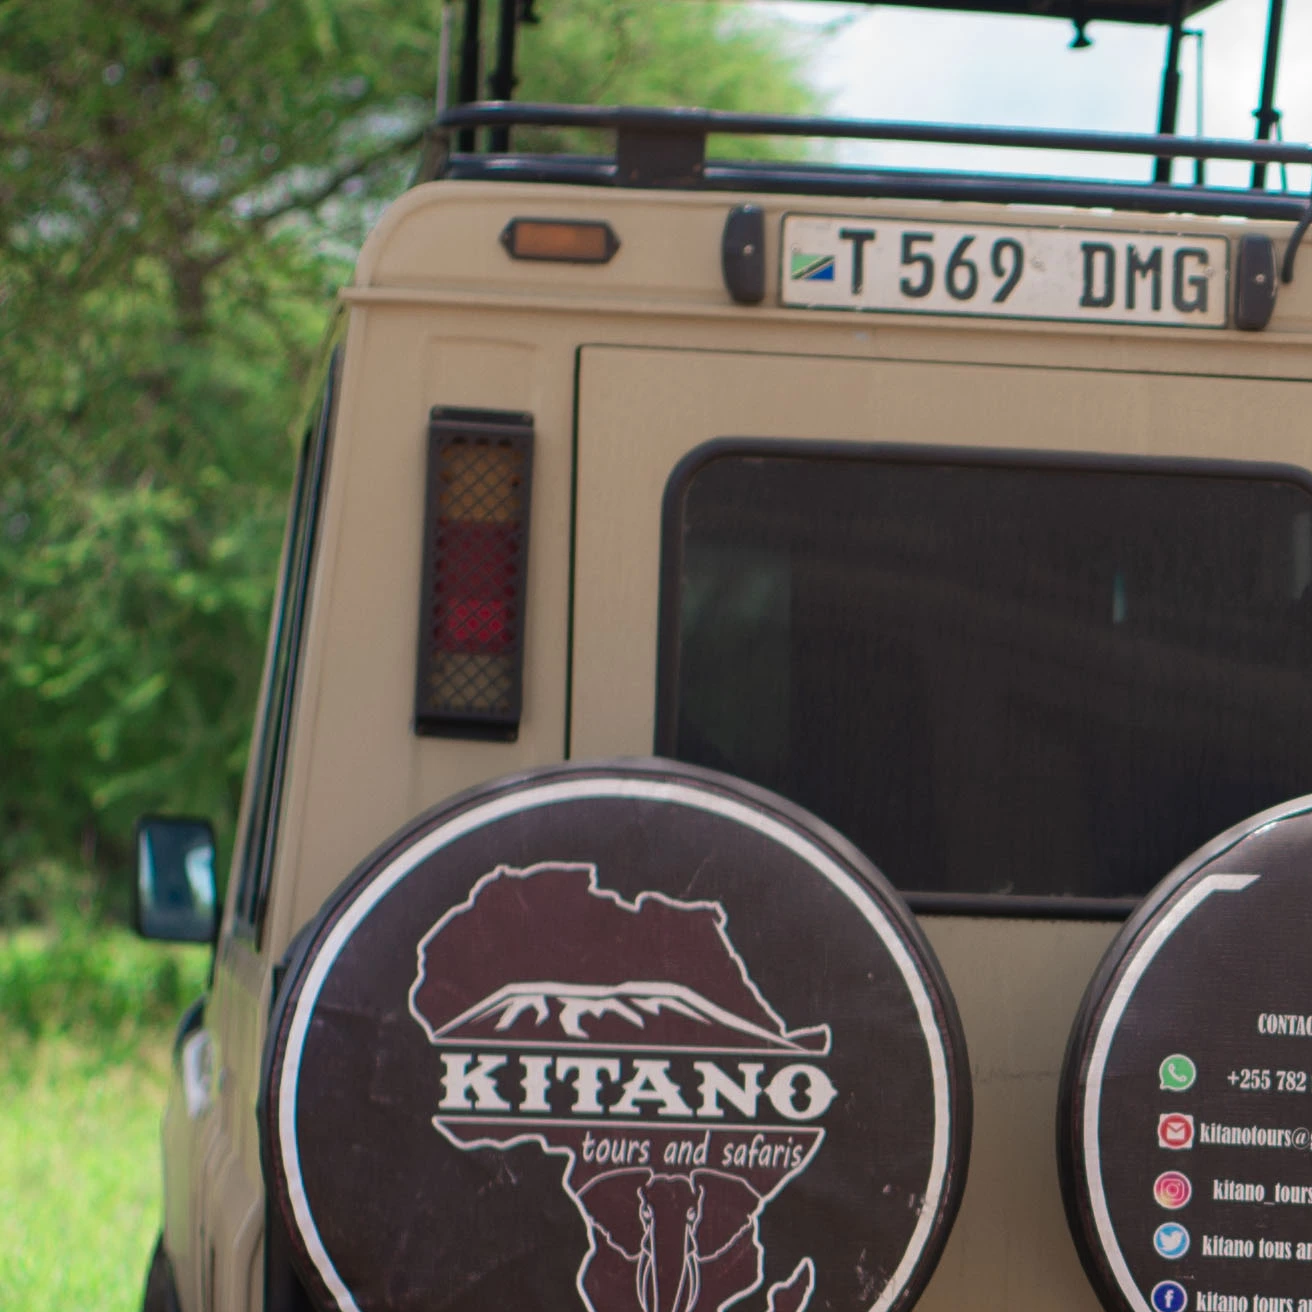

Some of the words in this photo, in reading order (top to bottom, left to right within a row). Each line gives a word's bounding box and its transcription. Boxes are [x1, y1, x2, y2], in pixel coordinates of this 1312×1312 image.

[839, 229, 876, 296] T
[899, 231, 1025, 303] 569
[1080, 241, 1209, 314] DMG
[438, 1052, 838, 1121] KITANO
[1227, 1068, 1271, 1090] +255
[1276, 1070, 1306, 1092] 782
[581, 1130, 651, 1165] tours
[663, 1131, 708, 1167] and
[721, 1133, 803, 1169] safaris
[1202, 1234, 1254, 1258] kitano
[1258, 1237, 1292, 1260] tous
